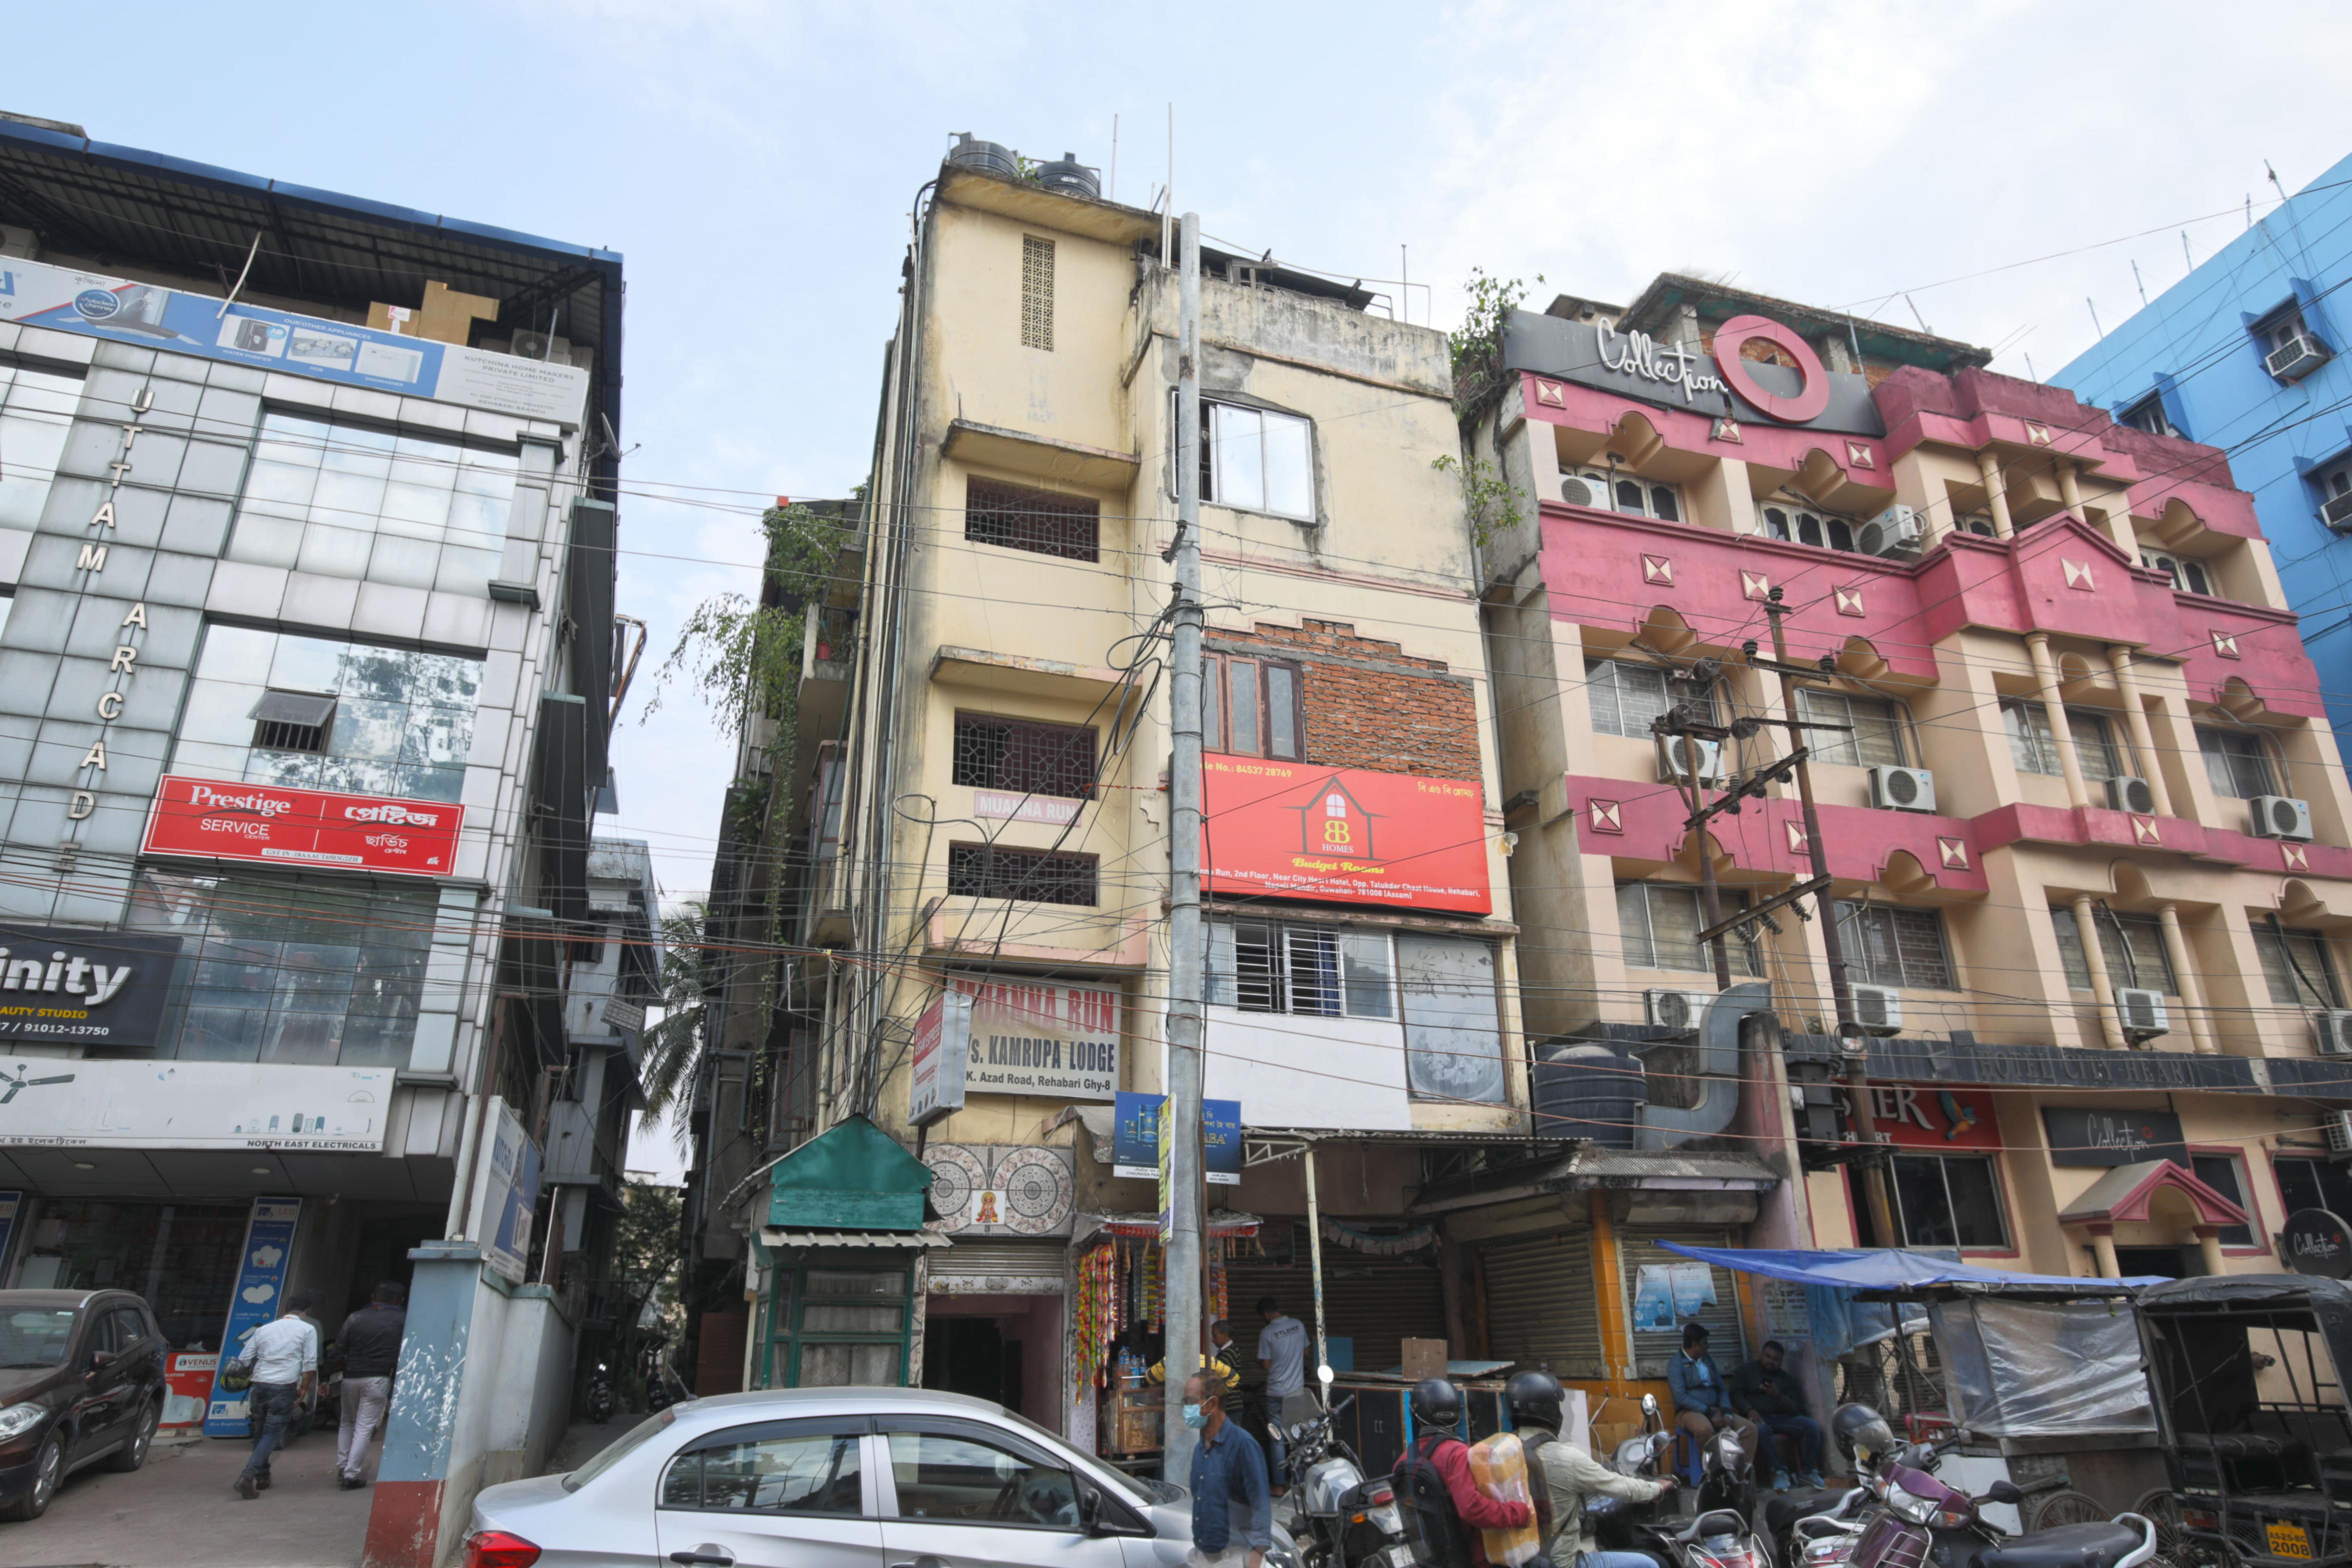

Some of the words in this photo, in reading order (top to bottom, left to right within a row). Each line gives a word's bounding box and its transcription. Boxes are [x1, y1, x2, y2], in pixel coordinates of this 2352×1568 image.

[85, 302, 114, 312] chimney
[302, 322, 326, 330] OTHER
[327, 327, 372, 340] APPLIANCES
[222, 349, 244, 358] WATER
[244, 352, 272, 362] PURIFIER
[1596, 316, 1729, 402] Collection
[464, 355, 510, 369] KUTCHINA
[512, 364, 538, 374] HOME
[539, 370, 574, 380] MAKERS
[482, 366, 518, 376] PRIVATE
[520, 372, 555, 383] LIMITED
[365, 376, 404, 387] DISHWASHER
[478, 399, 515, 408] REHABARI
[516, 405, 546, 414] BRANCH
[77, 388, 155, 573] UTTAM
[54, 602, 148, 873] ARCADE
[1236, 764, 1264, 774] 84537
[1265, 768, 1292, 778] 28769
[188, 785, 291, 817] Prestige
[980, 796, 1043, 818] MUANNA
[1046, 803, 1076, 820] RUN
[200, 818, 270, 836] SERVICE
[1322, 844, 1354, 854] HOMES
[1292, 857, 1338, 872] Budget
[1340, 862, 1385, 874] Rooms
[1216, 869, 1232, 878] Run,
[1234, 870, 1248, 878] 2nd
[1250, 872, 1272, 880] Floor,
[1273, 874, 1290, 882] Near
[1292, 874, 1306, 884] City
[1308, 876, 1328, 884] Heart
[1330, 878, 1351, 887] Hotel,
[1352, 880, 1369, 888] Opp.
[1370, 881, 1401, 890] Talukdar
[1402, 883, 1422, 892] Chaat
[1423, 886, 1446, 894] House,
[1448, 887, 1480, 898] Rehabari,
[1264, 881, 1288, 890] Nepali
[1290, 883, 1318, 892] Mandir,
[1357, 888, 1382, 896] 781008
[1384, 890, 1412, 900] (Assam)
[0, 1006, 34, 1016] AUTY
[37, 1008, 88, 1019] STUDIO
[1068, 988, 1114, 1035] RUN
[24, 1023, 110, 1036] 91012-13750
[988, 1034, 1062, 1070] KAMRUPA
[1069, 1042, 1114, 1073] LODGE
[1976, 1050, 2054, 1080] HOTEL
[2062, 1054, 2113, 1082] CITY
[2124, 1056, 2199, 1084] HEART
[980, 1072, 1004, 1084] Azad
[1007, 1073, 1035, 1088] Road,
[1038, 1075, 1081, 1089] Rehabari
[1083, 1078, 1111, 1092] Ghy-8
[312, 1142, 376, 1150] ELECTRICALS
[1204, 1133, 1226, 1144] ABA
[1844, 1131, 1892, 1144] HRT
[2087, 1113, 2150, 1162] Collection
[2293, 1232, 2340, 1260] Collection
[2271, 1540, 2310, 1556] 2008
